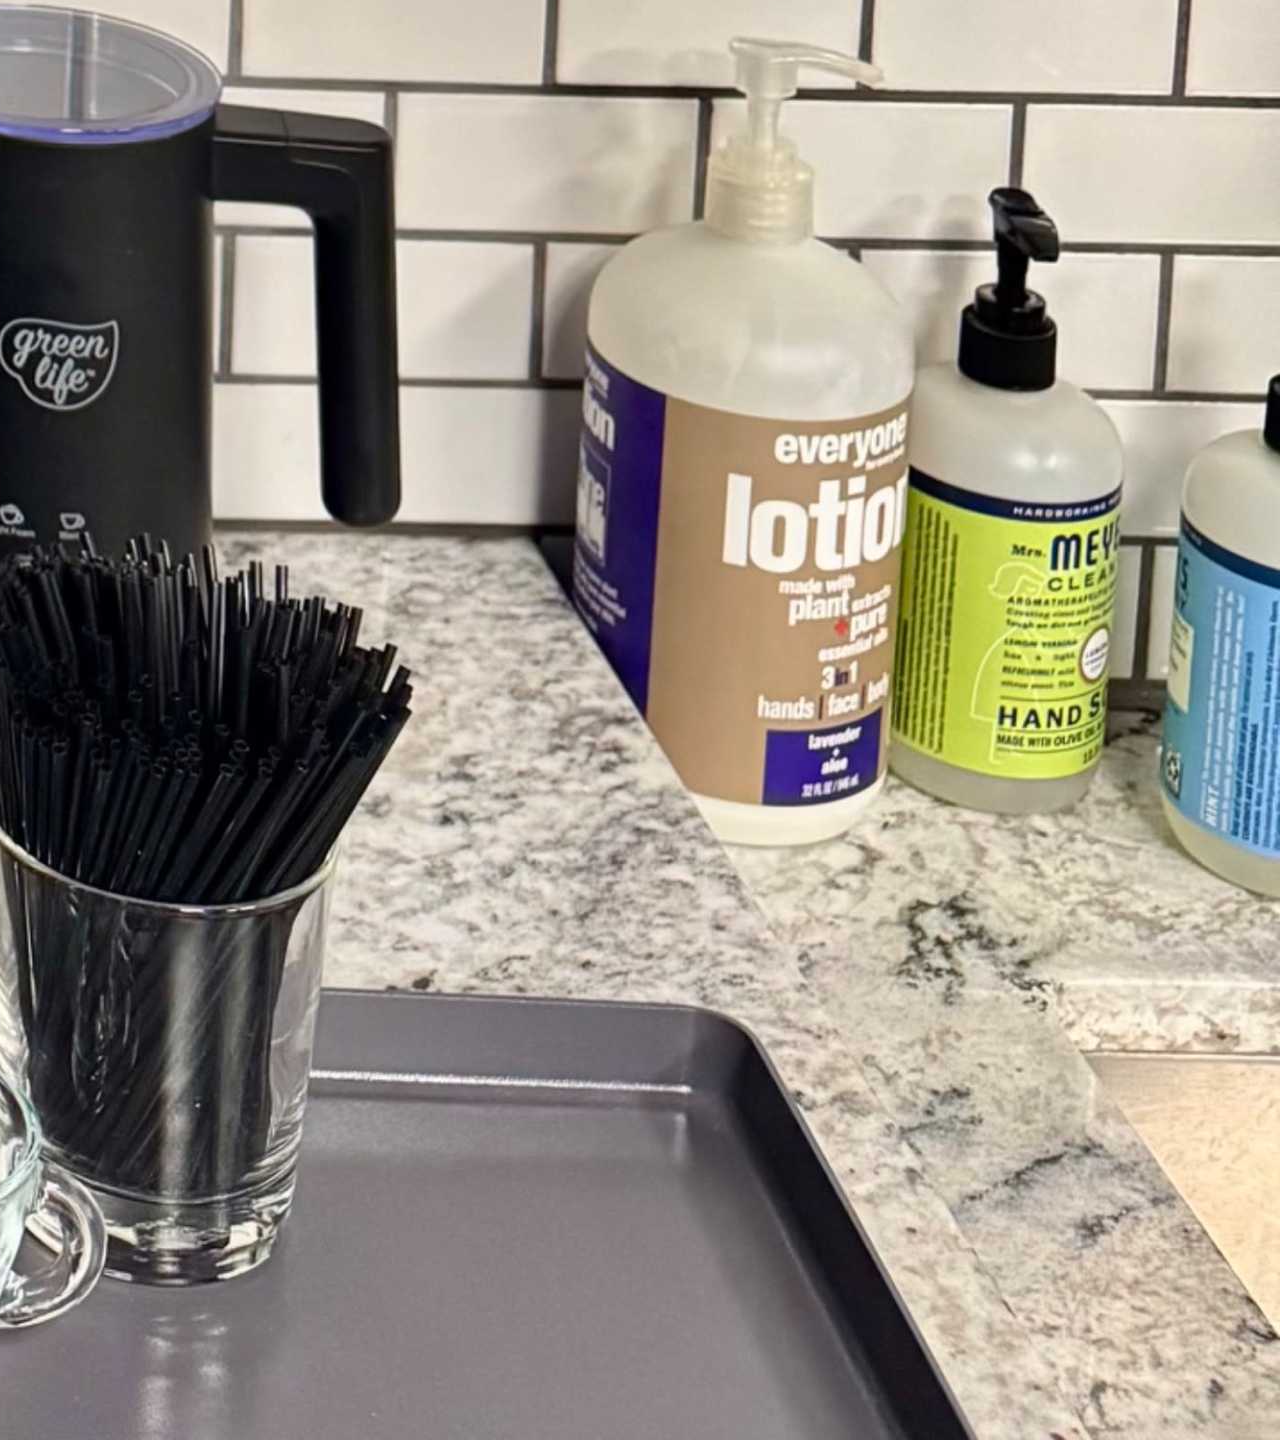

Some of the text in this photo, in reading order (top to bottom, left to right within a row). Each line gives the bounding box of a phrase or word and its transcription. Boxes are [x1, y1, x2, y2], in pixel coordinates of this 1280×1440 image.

[13, 327, 109, 369] green
[774, 412, 908, 468] everyone
[1013, 502, 1106, 518] HARDWORKING
[1011, 522, 1120, 571] Mrs. MEY
[779, 573, 856, 594] made with
[788, 589, 851, 626] plant
[757, 694, 815, 720] hands
[828, 693, 860, 716] face
[998, 691, 1105, 728] HAND S
[997, 734, 1024, 747] MADE
[1028, 735, 1051, 748] WITH
[1054, 731, 1082, 746] OLIVE
